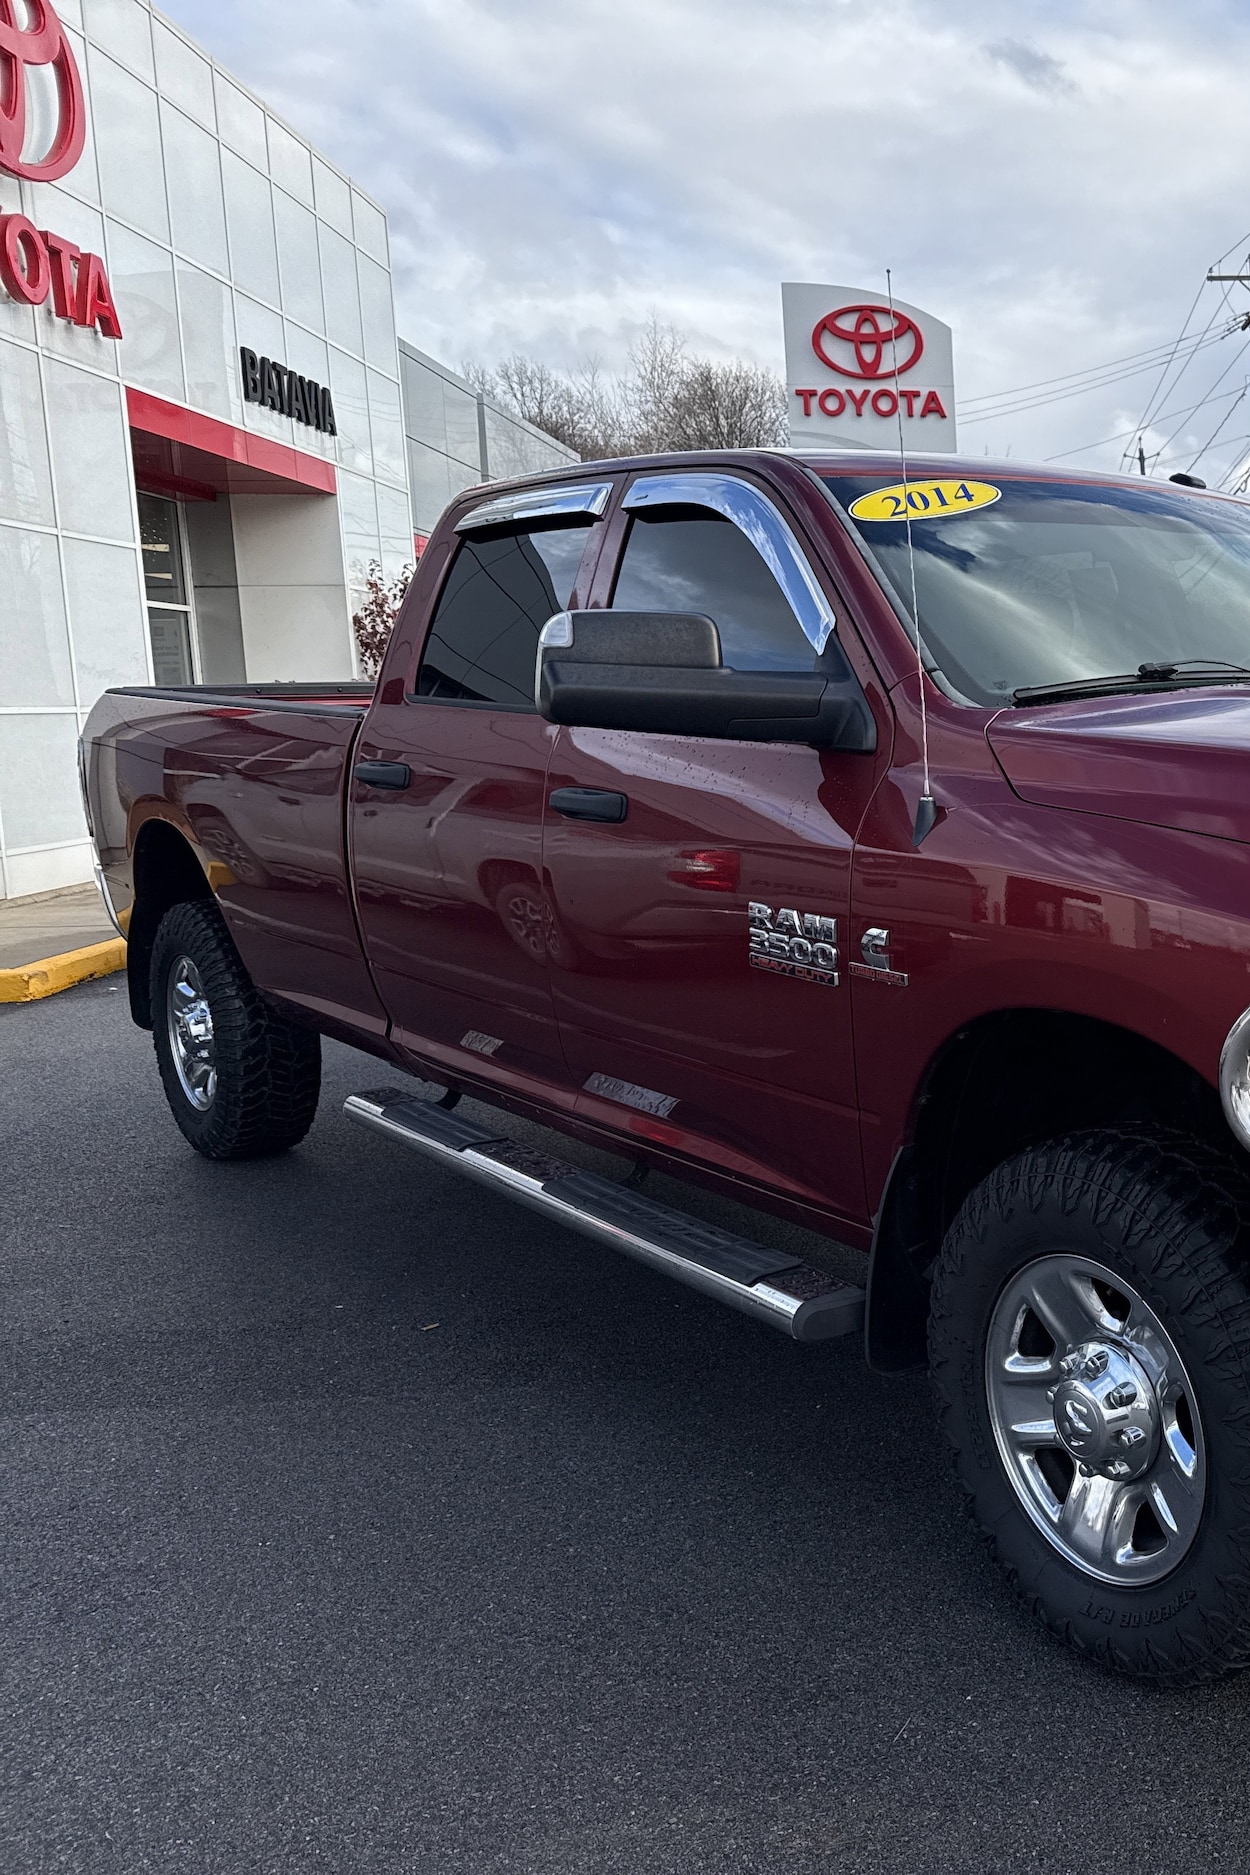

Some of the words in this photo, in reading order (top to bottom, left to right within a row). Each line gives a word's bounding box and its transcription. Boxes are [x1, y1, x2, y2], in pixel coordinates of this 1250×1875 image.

[0, 203, 122, 340] OTA
[239, 345, 338, 436] BATAVIA
[794, 388, 947, 418] TOYOTA
[881, 482, 975, 517] 2014
[748, 901, 837, 942] RAM
[749, 927, 837, 969] 3500
[752, 956, 792, 973] HEAVY
[794, 964, 833, 983] DUTY
